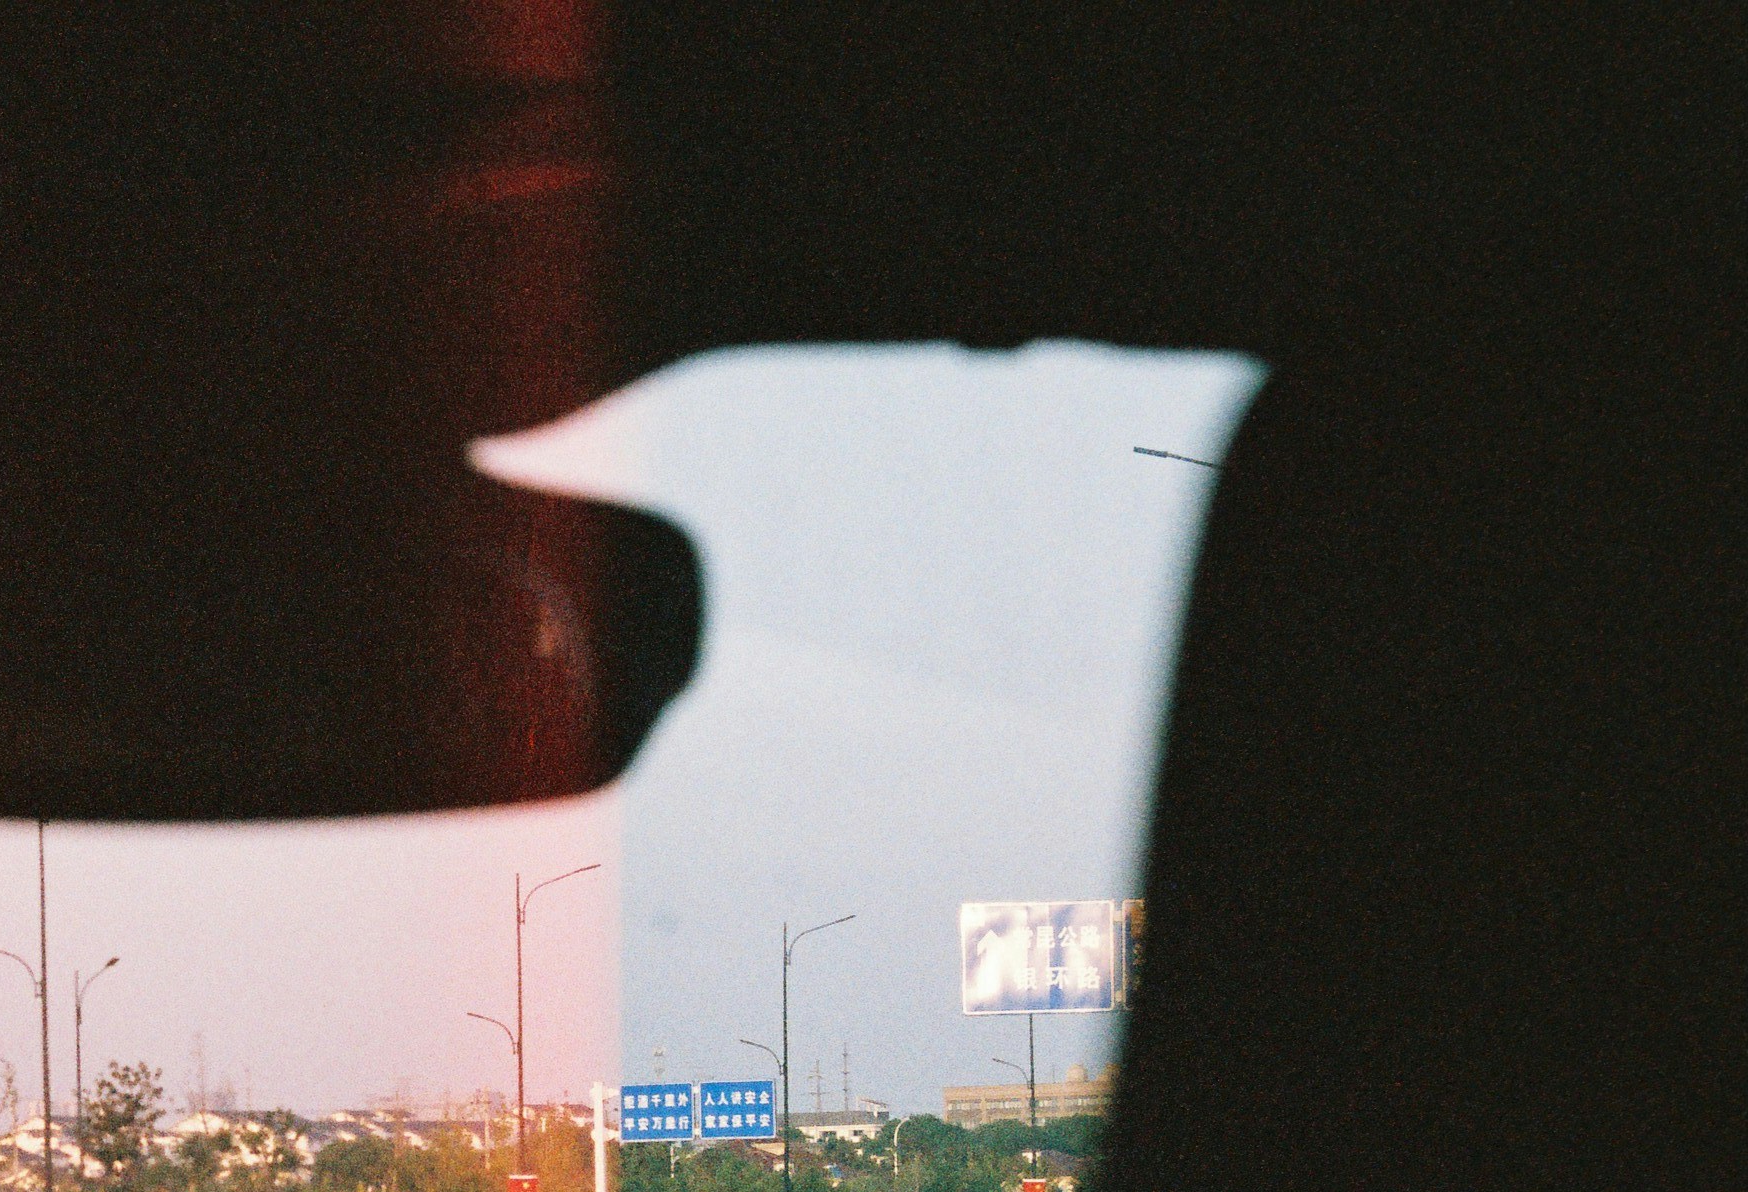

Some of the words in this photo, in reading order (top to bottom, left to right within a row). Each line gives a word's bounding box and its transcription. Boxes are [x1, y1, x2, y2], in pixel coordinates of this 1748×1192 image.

[704, 1090, 770, 1106] 人人讲安全
